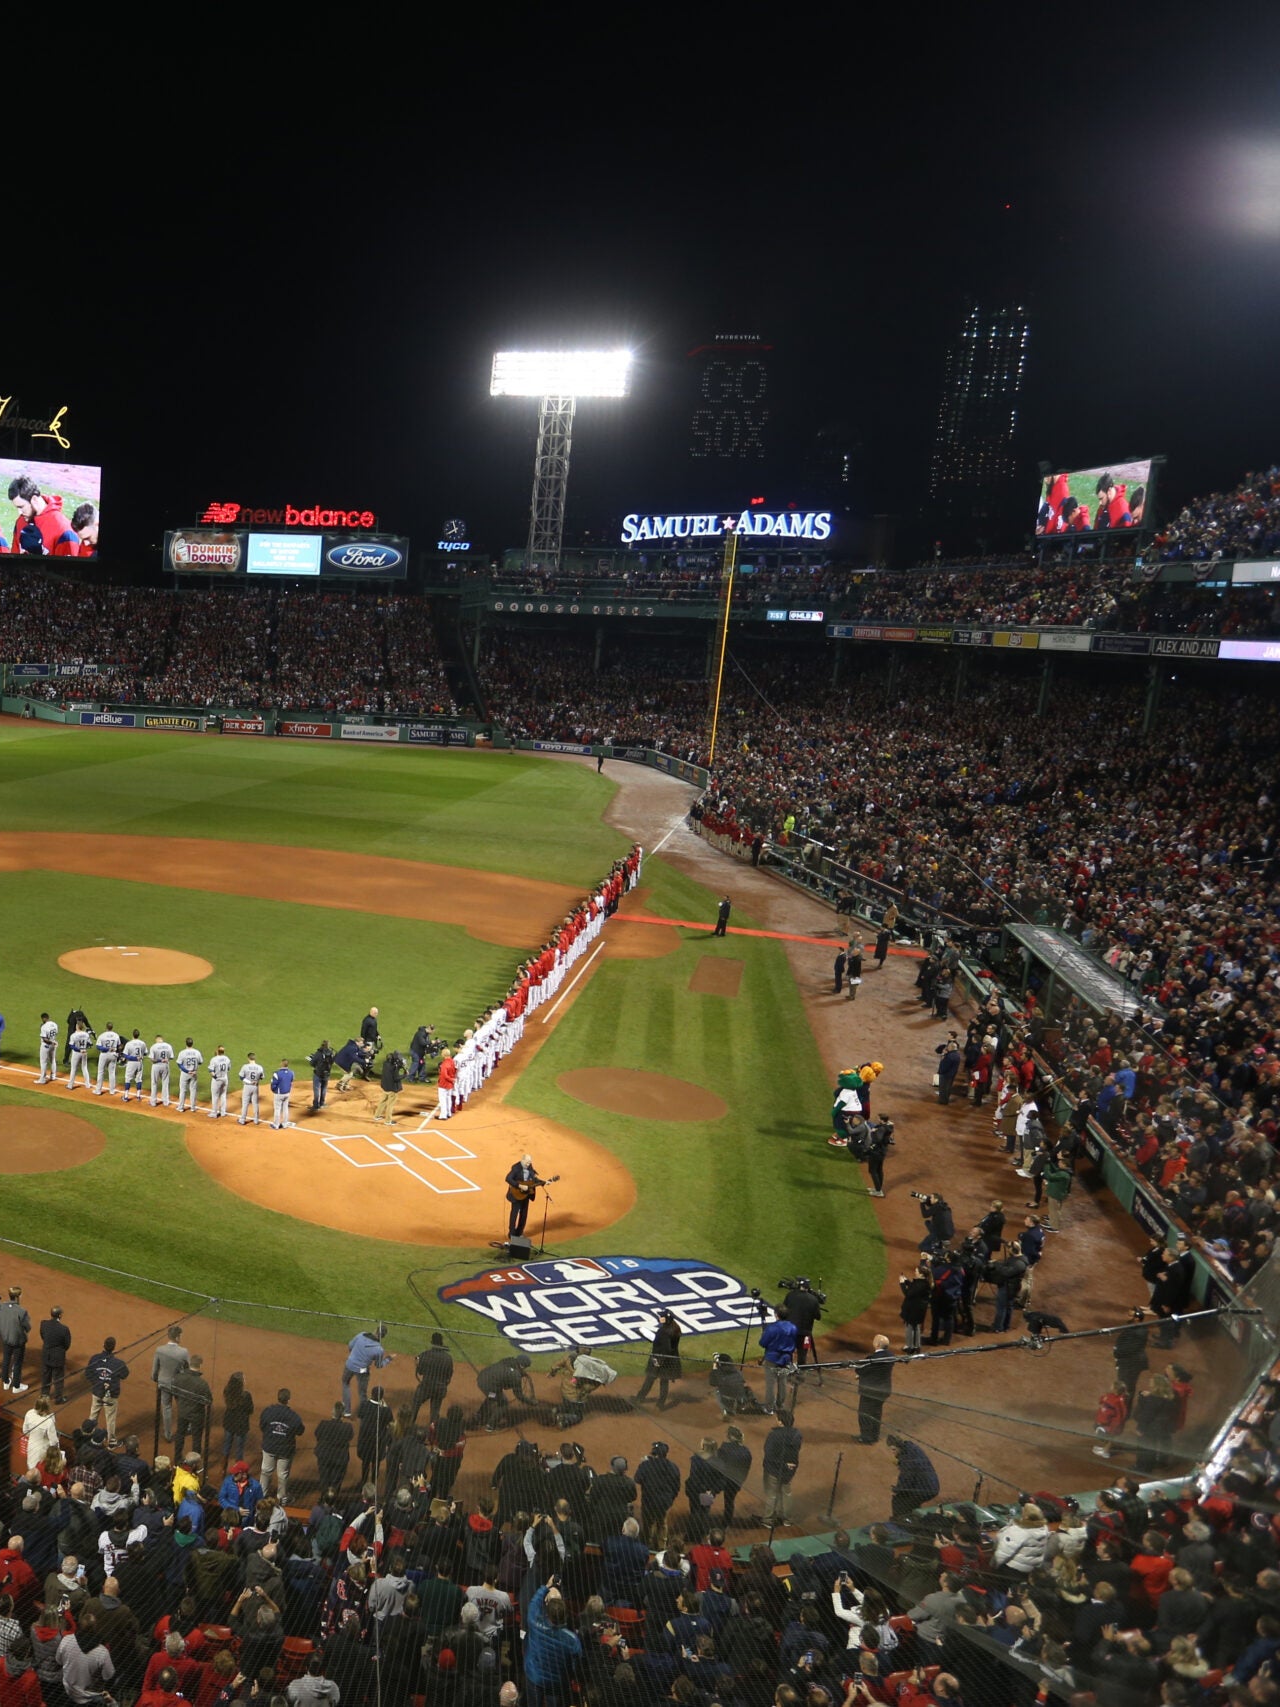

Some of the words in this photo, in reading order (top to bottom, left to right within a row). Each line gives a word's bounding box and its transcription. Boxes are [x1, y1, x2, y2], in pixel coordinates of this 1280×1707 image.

[241, 507, 282, 523] new
[285, 505, 375, 527] balance
[621, 513, 722, 543] SAMUEL
[734, 510, 831, 540] ADAMS
[192, 544, 237, 555] DUNKIN'
[437, 540, 470, 552] tyco
[191, 553, 234, 564] DONUTS
[341, 546, 386, 567] Ford
[1156, 641, 1177, 653] ALEX
[1179, 641, 1198, 655] AND
[93, 713, 122, 725] jetBlue
[288, 723, 318, 735] xfinity
[106, 1040, 115, 1048] 27
[489, 1271, 525, 1283] 20
[606, 1258, 639, 1271] 18
[456, 1270, 742, 1323] WORLD
